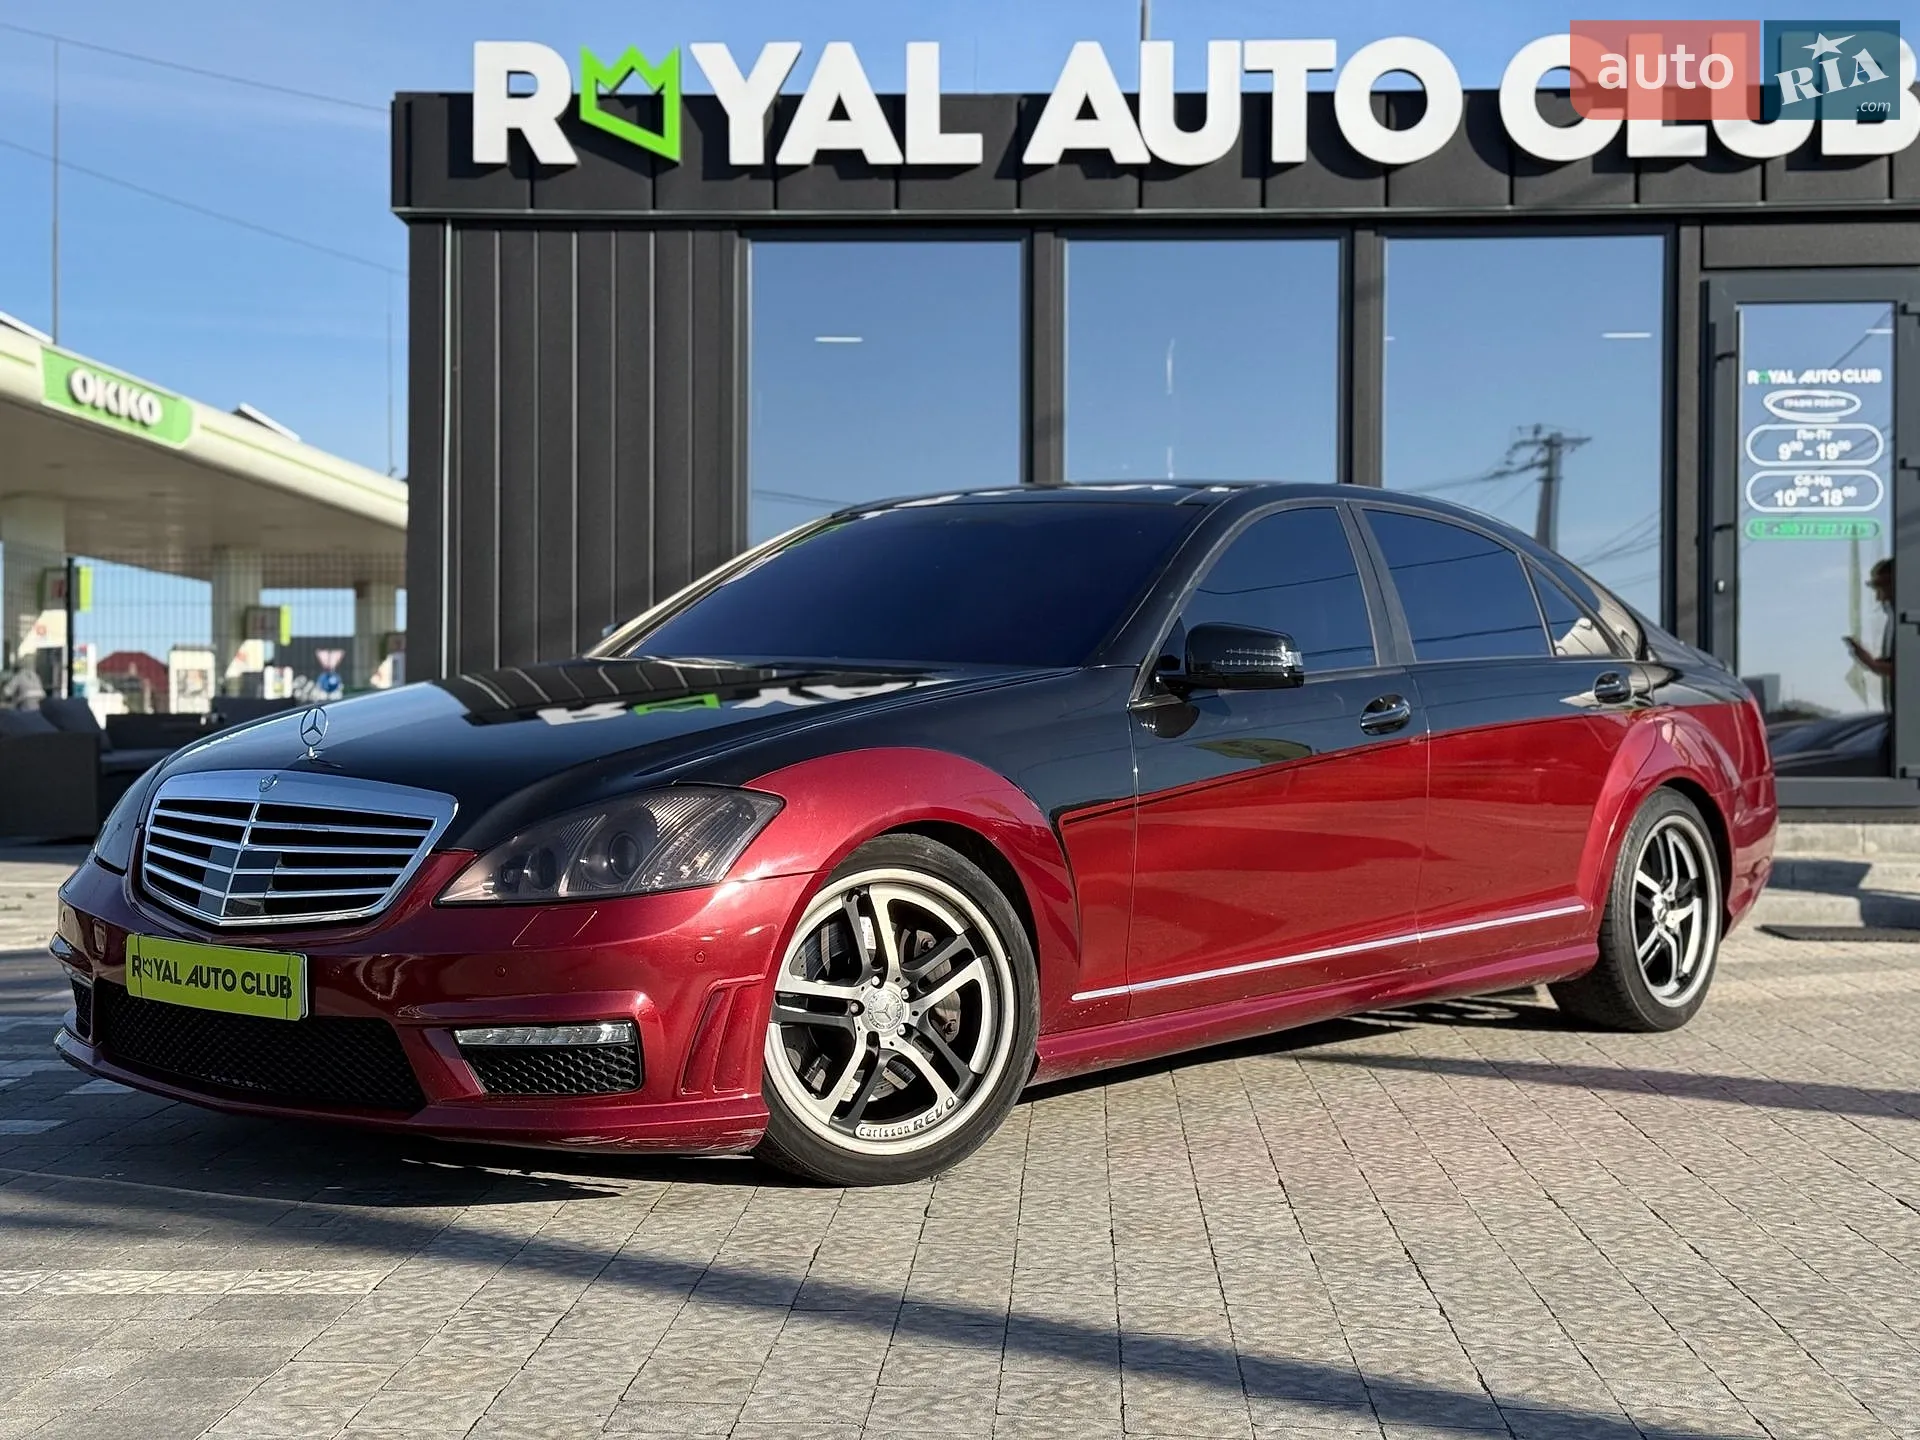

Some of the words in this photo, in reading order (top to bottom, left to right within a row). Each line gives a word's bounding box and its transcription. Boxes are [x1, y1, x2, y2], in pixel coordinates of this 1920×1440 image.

[1022, 37, 1463, 166] AUTO
[1499, 31, 1920, 162] CLUB
[69, 368, 163, 426] OKKO
[1798, 368, 1841, 384] AUTO
[1842, 368, 1882, 384] CLUB
[185, 967, 237, 992] AUTO
[240, 971, 292, 999] CLUB
[859, 1125, 911, 1138] Carlsson
[913, 1096, 955, 1131] REVO
